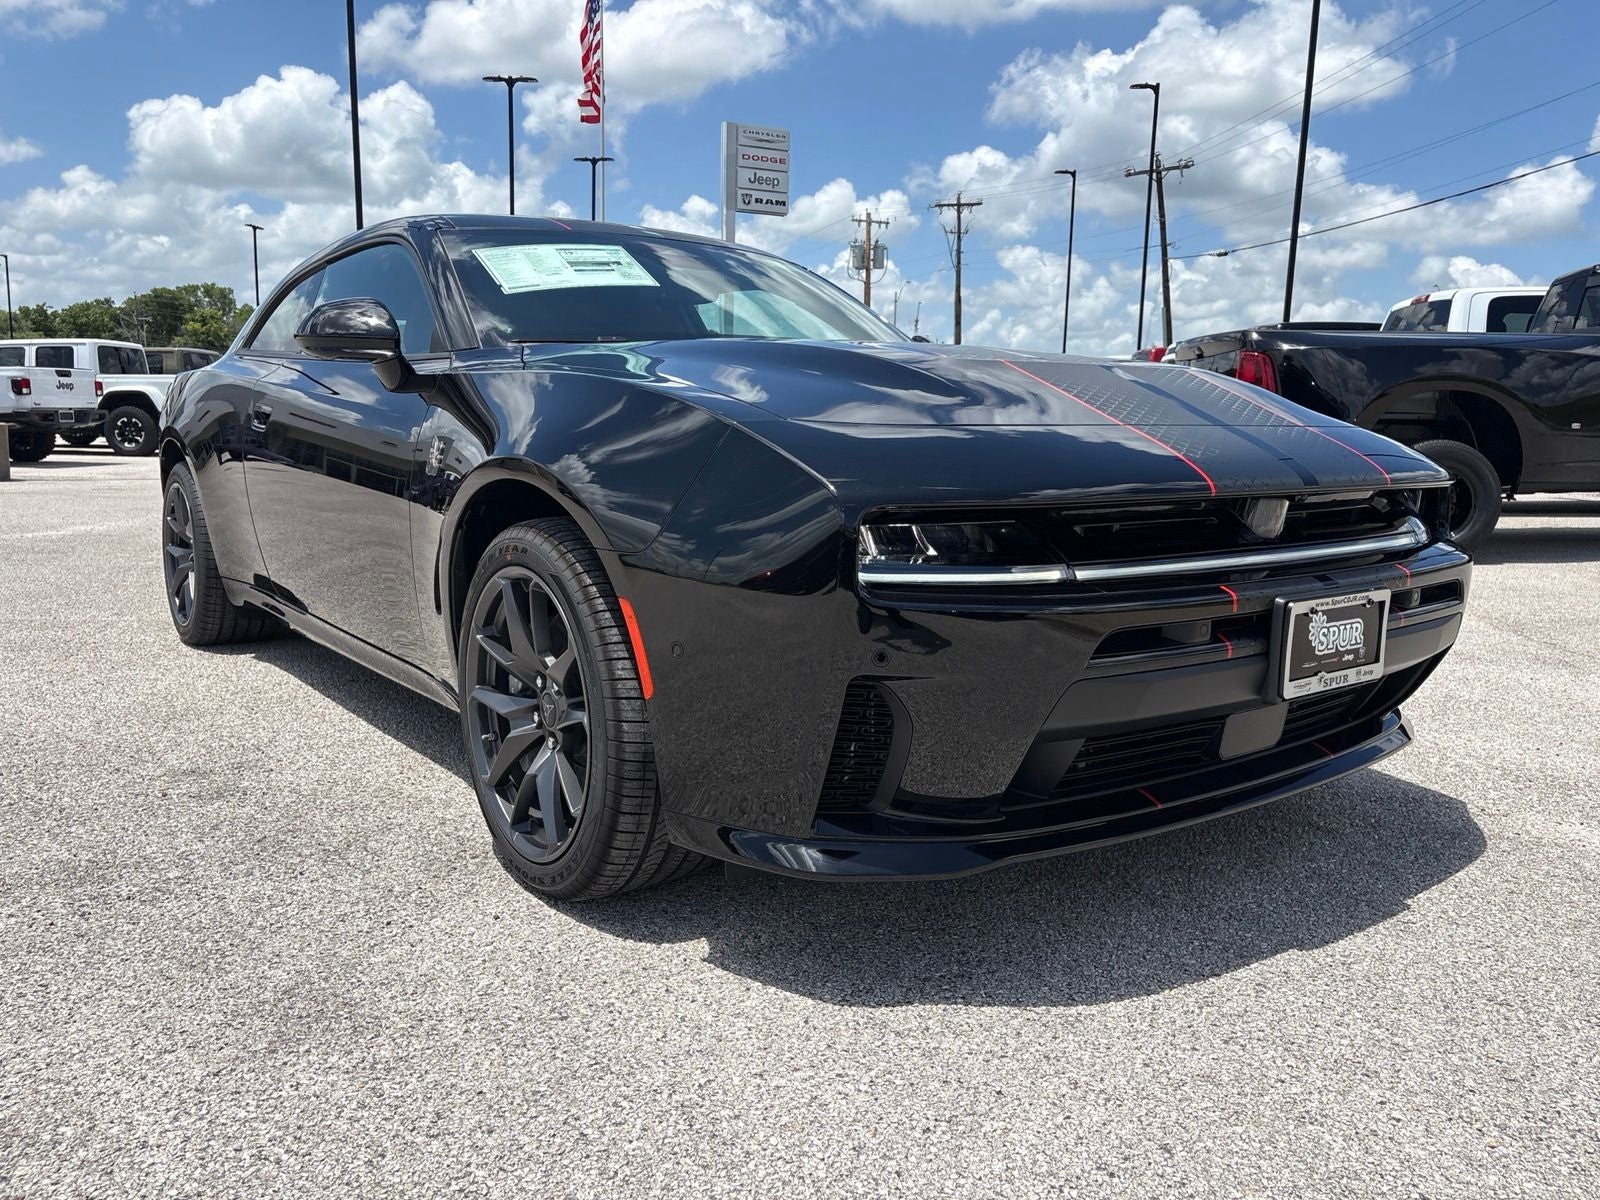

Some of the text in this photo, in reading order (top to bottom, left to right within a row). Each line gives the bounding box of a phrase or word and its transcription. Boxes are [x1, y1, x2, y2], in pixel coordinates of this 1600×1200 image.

[742, 129, 786, 139] CHRYSLER
[741, 153, 787, 165] DODGE
[748, 171, 780, 189] Jeep
[754, 197, 786, 207] RAM
[56, 380, 75, 392] Jeep
[1316, 620, 1362, 653] SPUR
[1342, 653, 1355, 662] Jeep
[1362, 669, 1374, 677] Jeep
[1322, 674, 1349, 688] SPUR
